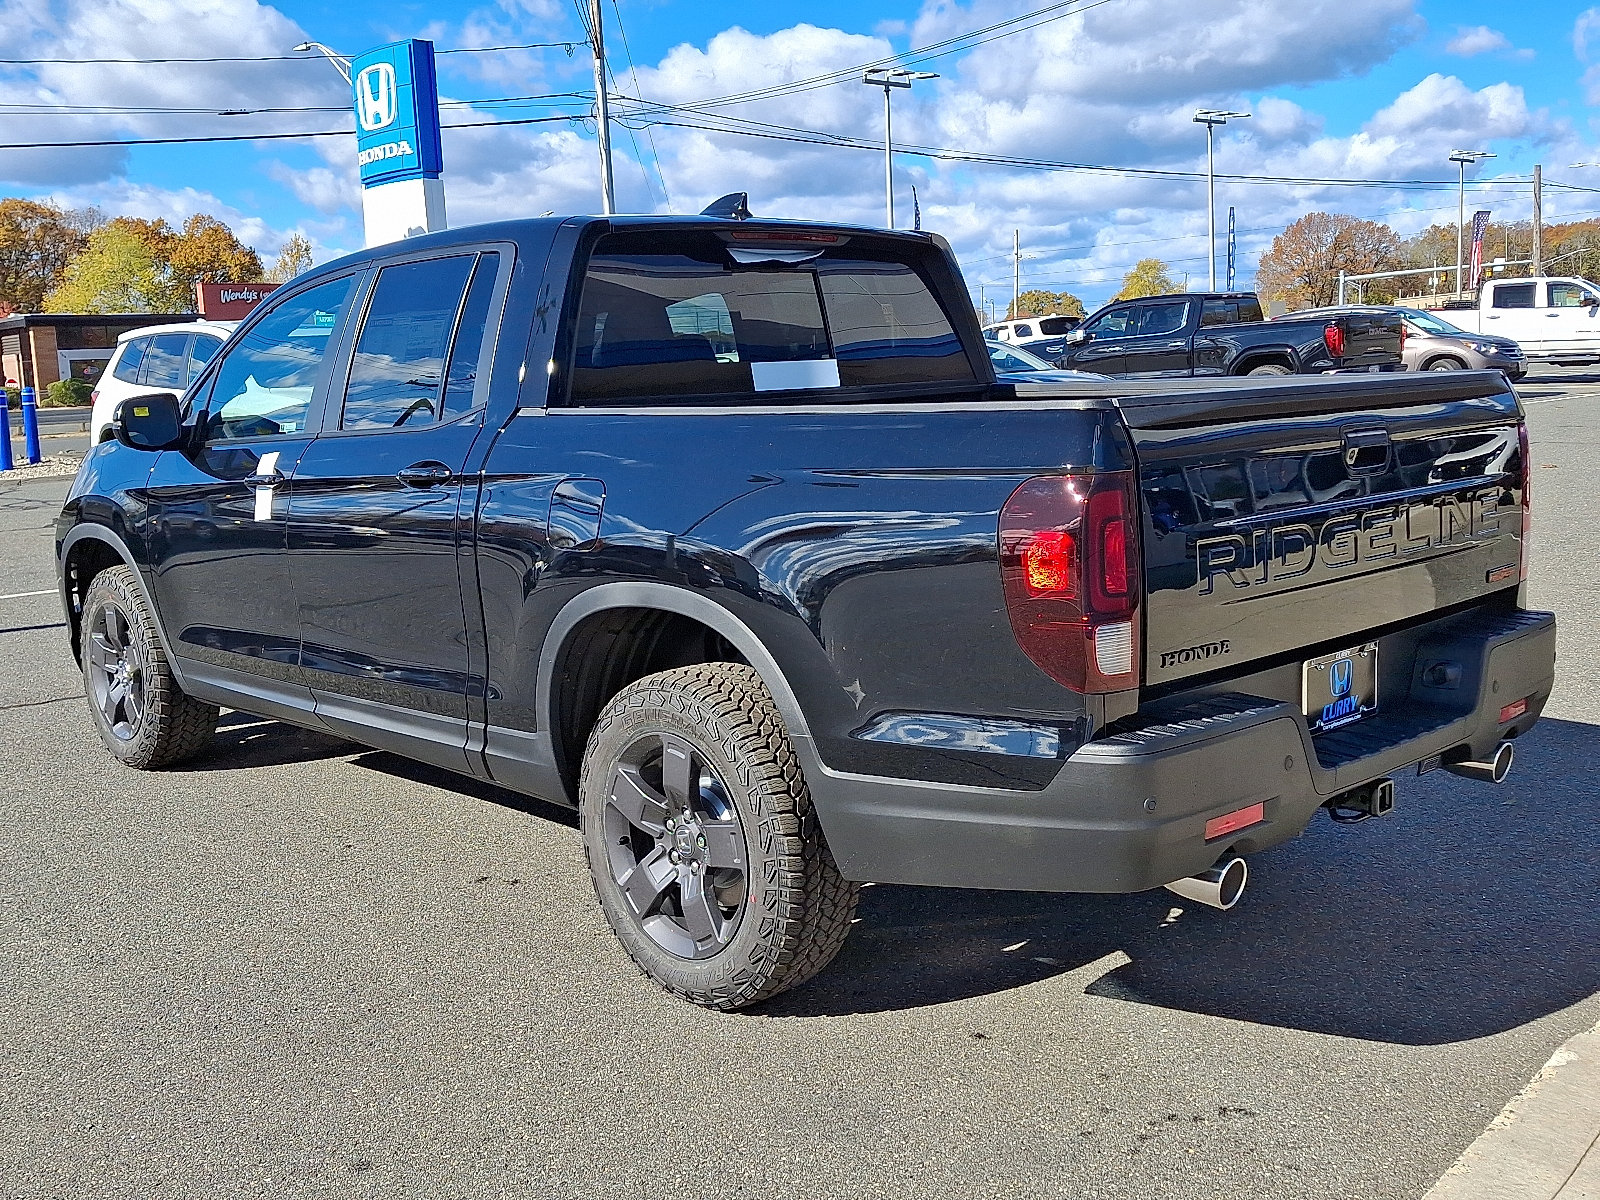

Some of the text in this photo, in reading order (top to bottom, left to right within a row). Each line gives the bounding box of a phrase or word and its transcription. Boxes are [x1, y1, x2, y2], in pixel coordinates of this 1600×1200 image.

[358, 140, 414, 167] HONDA
[221, 287, 258, 303] Wendy's
[1196, 487, 1500, 597] RIDGELINE
[1160, 639, 1231, 668] HONDA
[1322, 695, 1359, 721] CURRY
